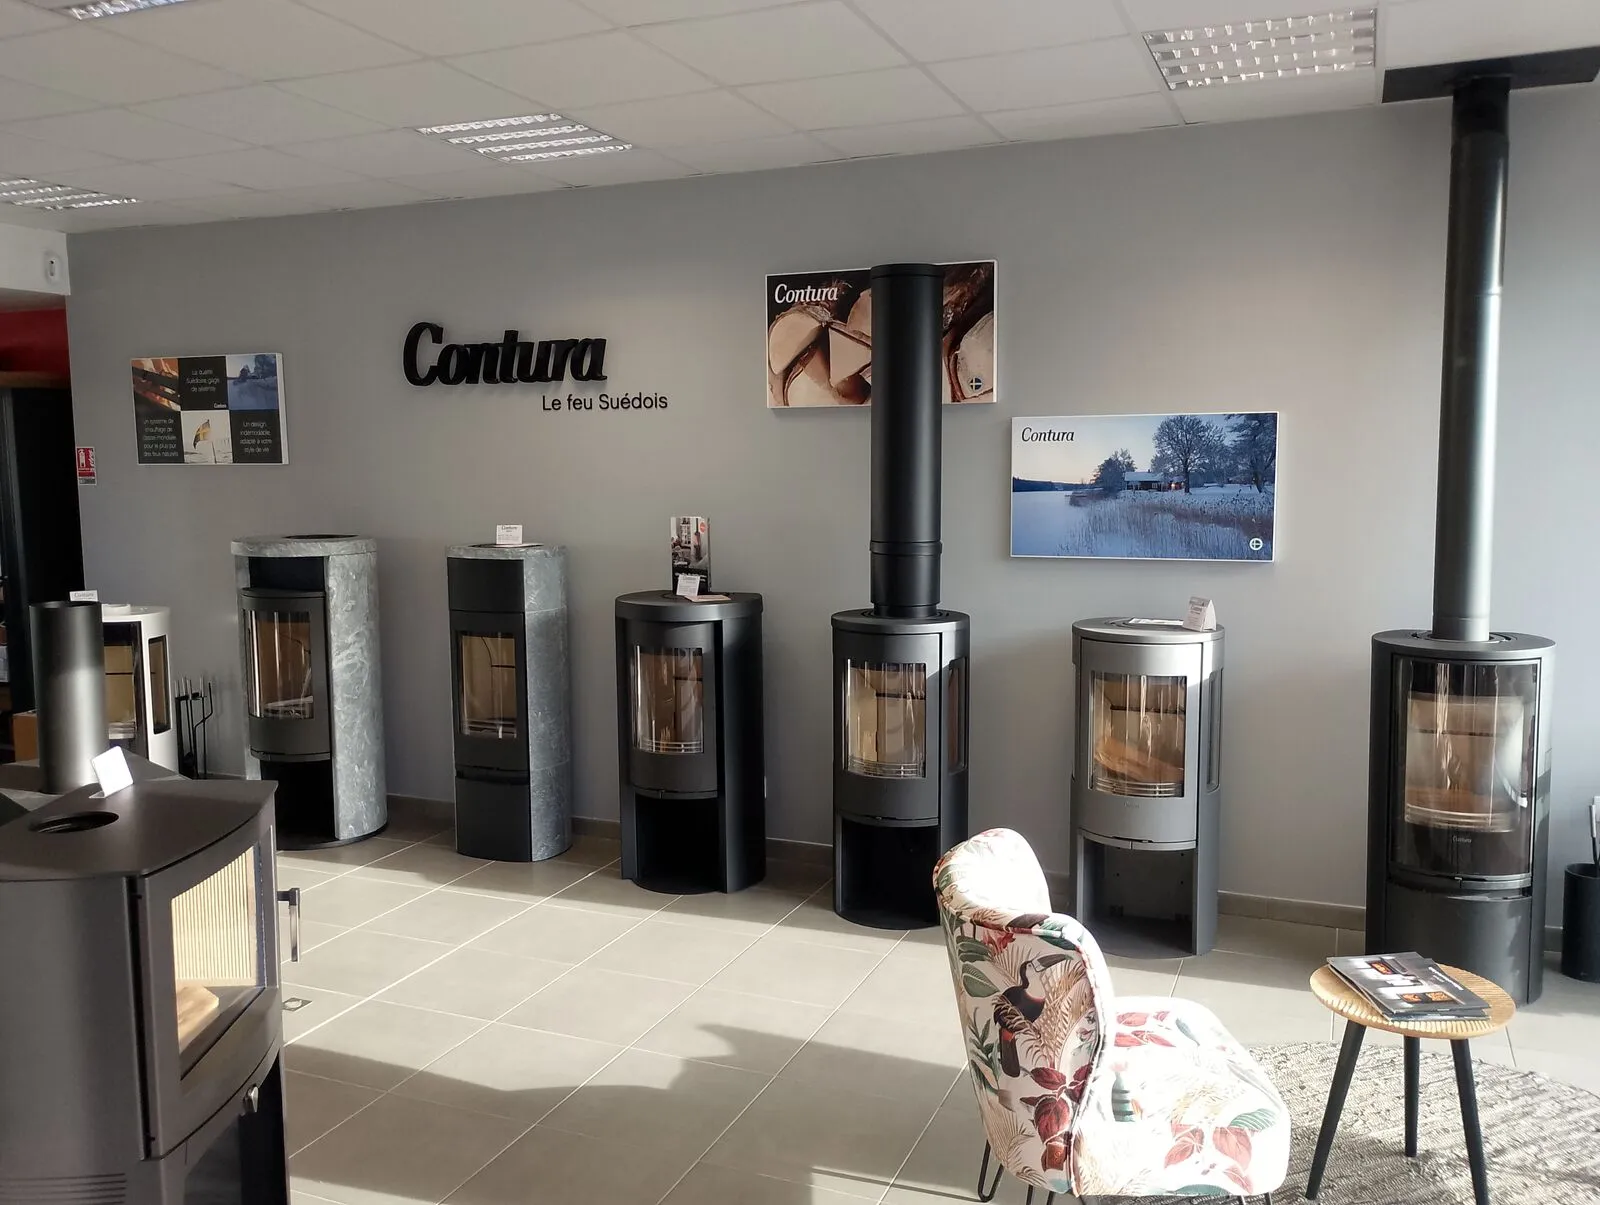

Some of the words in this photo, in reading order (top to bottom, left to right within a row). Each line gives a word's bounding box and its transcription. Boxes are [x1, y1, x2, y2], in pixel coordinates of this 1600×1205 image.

[774, 283, 839, 304] Contura
[403, 321, 608, 386] Contura
[542, 394, 562, 411] Le
[567, 393, 593, 410] feu
[598, 391, 669, 410] Suédois
[1021, 426, 1075, 443] Contura
